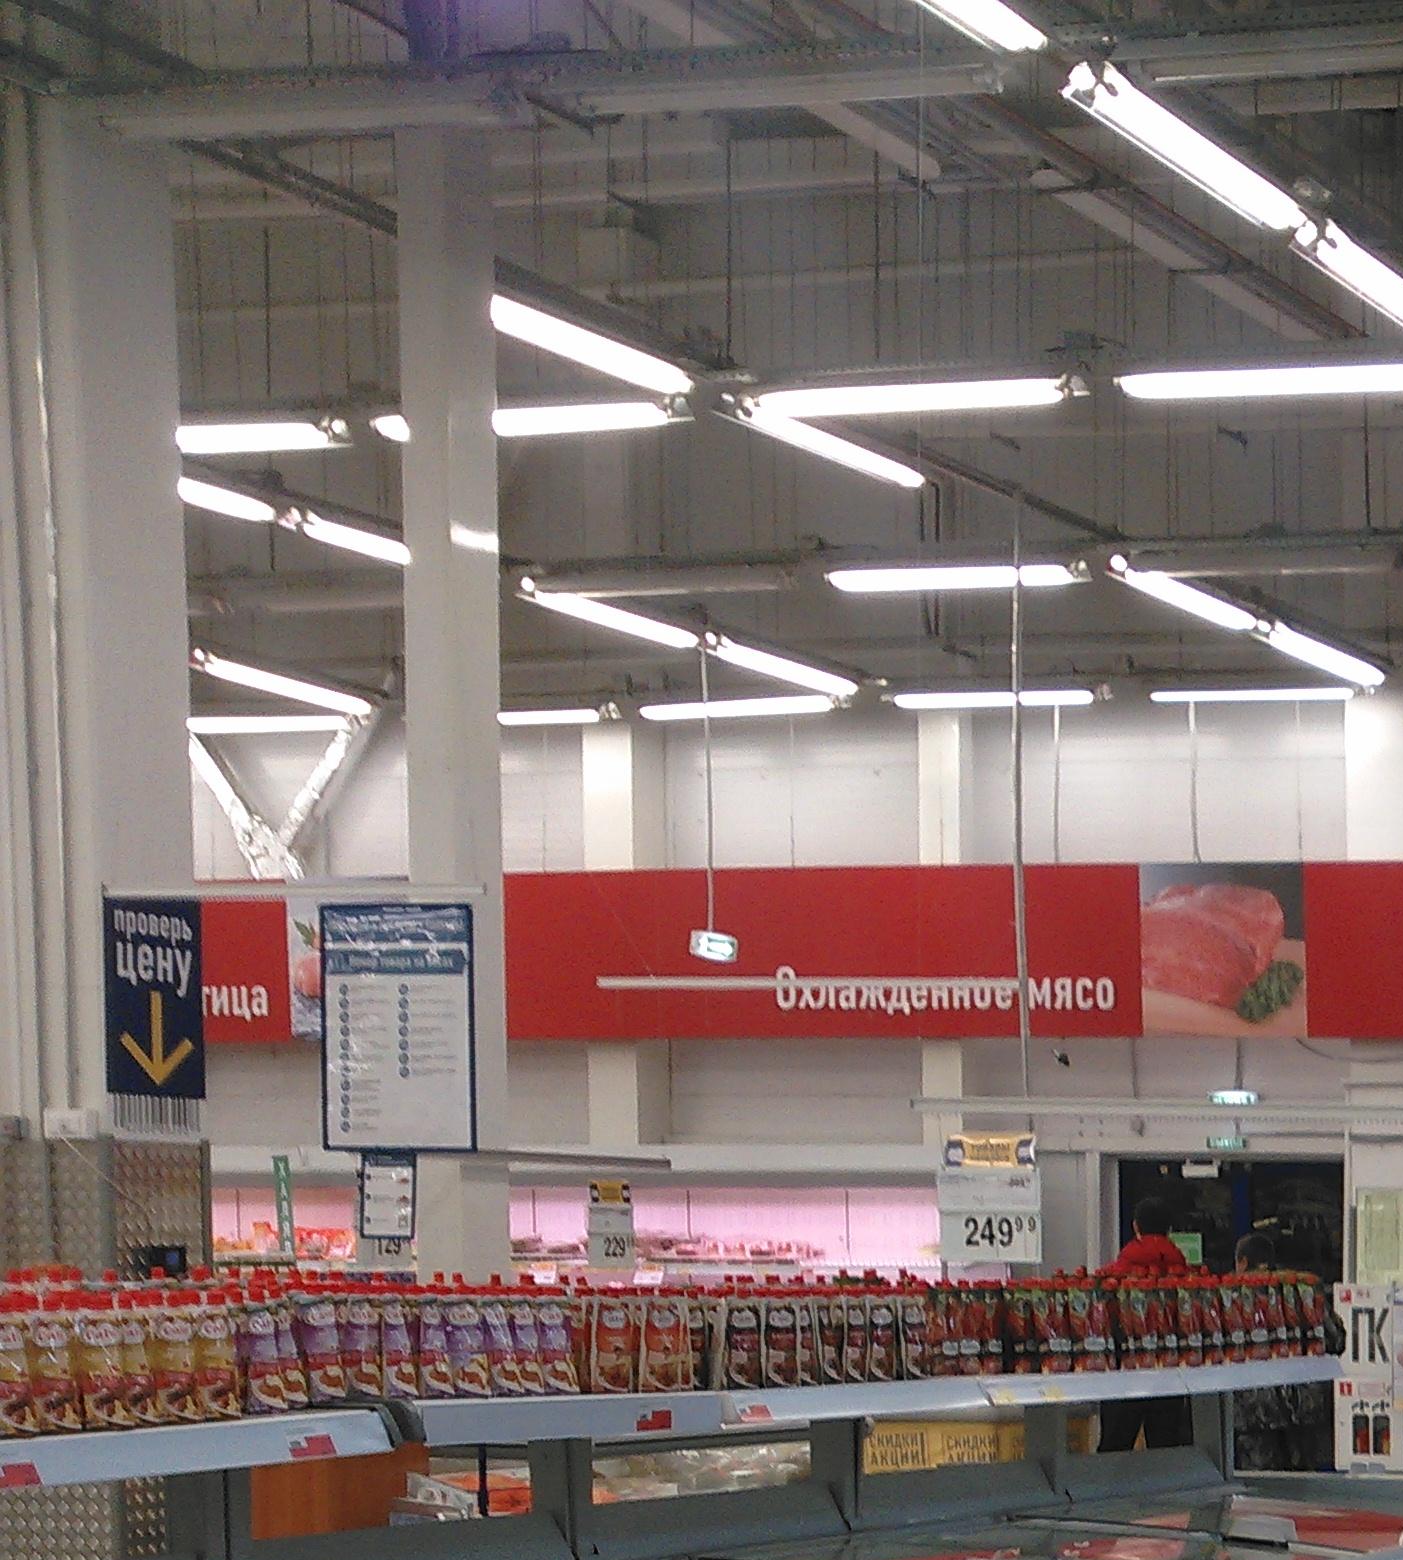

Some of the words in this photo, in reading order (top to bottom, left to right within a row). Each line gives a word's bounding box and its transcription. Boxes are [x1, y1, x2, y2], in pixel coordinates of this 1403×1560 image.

[112, 908, 194, 946] проверь
[115, 940, 194, 998] цену
[202, 983, 270, 1022] тица
[1027, 976, 1116, 1012] мясо
[869, 1432, 919, 1450] СКИДКИ
[869, 1449, 920, 1468] АКЦИИ
[947, 1433, 998, 1450] СКИДКИ
